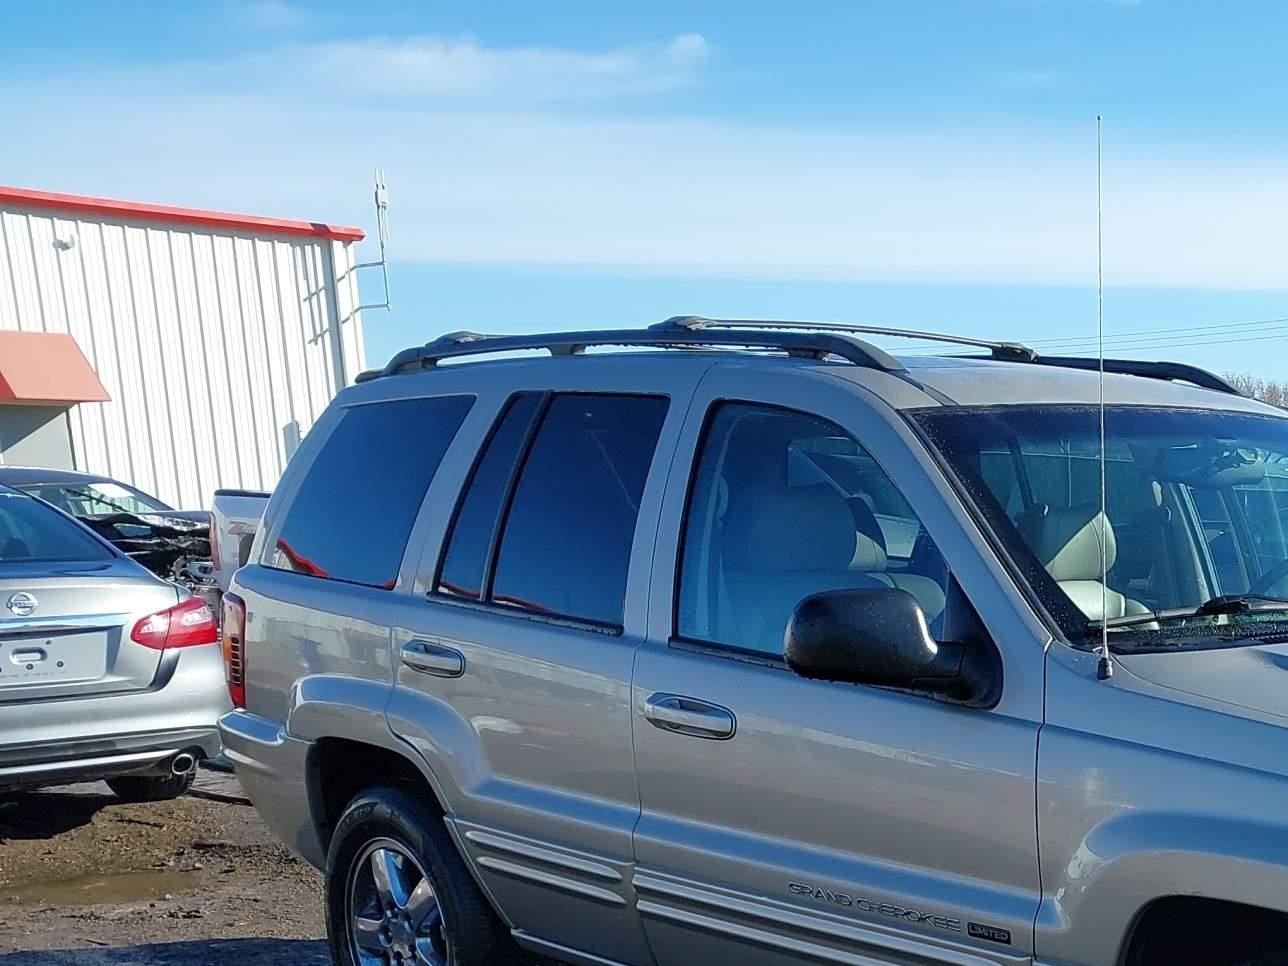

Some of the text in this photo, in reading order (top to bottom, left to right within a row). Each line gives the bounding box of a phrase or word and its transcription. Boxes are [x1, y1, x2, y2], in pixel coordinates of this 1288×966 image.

[789, 881, 1009, 941] GRAND CHEROKEE LIMITED
